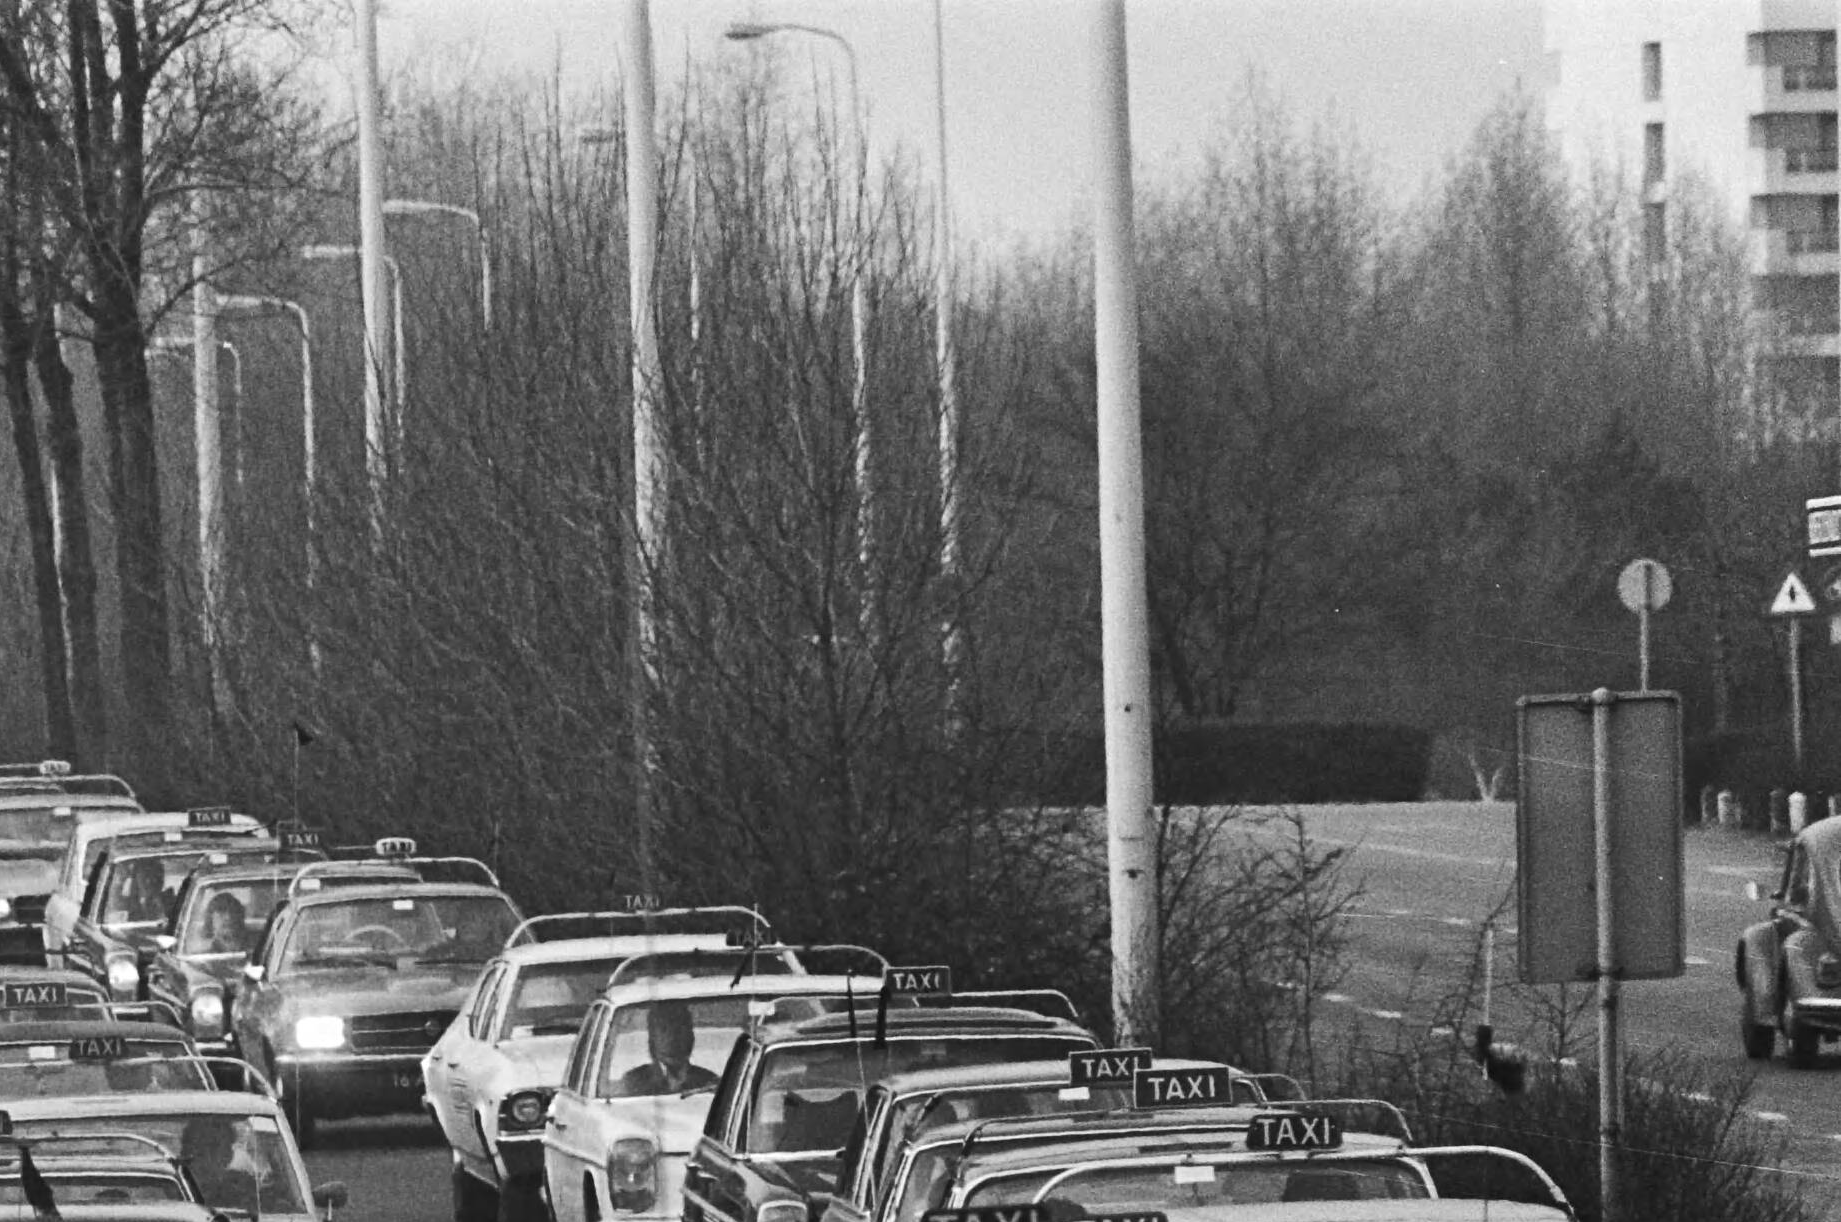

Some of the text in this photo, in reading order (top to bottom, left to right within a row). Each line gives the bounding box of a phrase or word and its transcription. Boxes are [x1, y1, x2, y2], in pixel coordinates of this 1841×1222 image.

[196, 811, 226, 823] TAXI
[288, 833, 320, 846] TAXI
[625, 895, 660, 908] TAXI
[892, 972, 940, 989] TAXI
[14, 986, 57, 1003] TAXI
[78, 1039, 122, 1056] TAXI
[1081, 1057, 1139, 1077] TAXI
[1148, 1075, 1215, 1101] TAXI
[1257, 1117, 1330, 1145] TAXI
